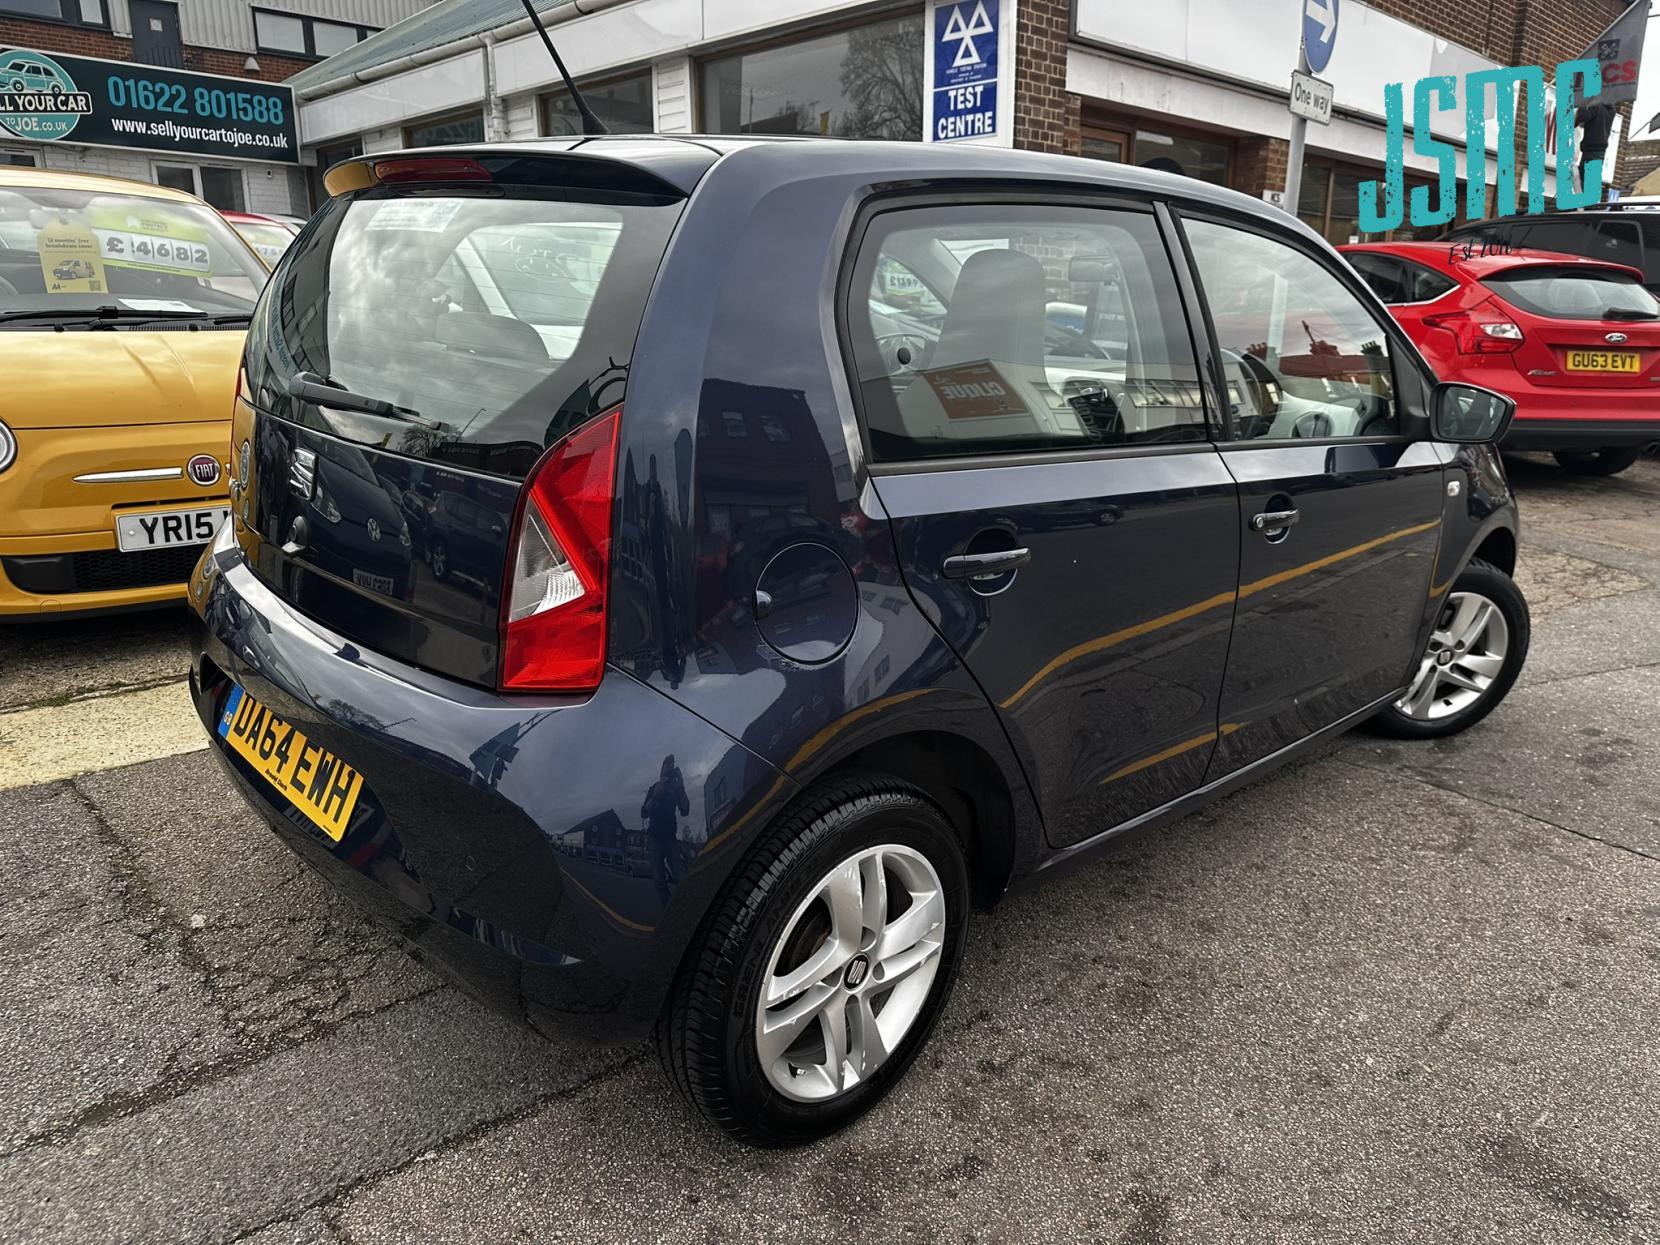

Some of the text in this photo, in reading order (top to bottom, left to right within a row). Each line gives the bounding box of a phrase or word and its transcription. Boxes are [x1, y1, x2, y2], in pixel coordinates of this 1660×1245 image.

[15, 95, 56, 111] YOUR
[57, 95, 88, 111] CAR
[107, 75, 284, 125] 01622 801588
[948, 85, 984, 111] TEST
[1295, 82, 1329, 115] One way
[112, 118, 288, 148] www.sellyourcartojoe.co.uk
[938, 111, 993, 139] CENTRE
[1572, 353, 1636, 369] GU63 EVT
[194, 463, 214, 479] FIAT
[139, 511, 214, 545] YR15
[233, 691, 296, 774] DA64
[290, 738, 357, 824] EWH
